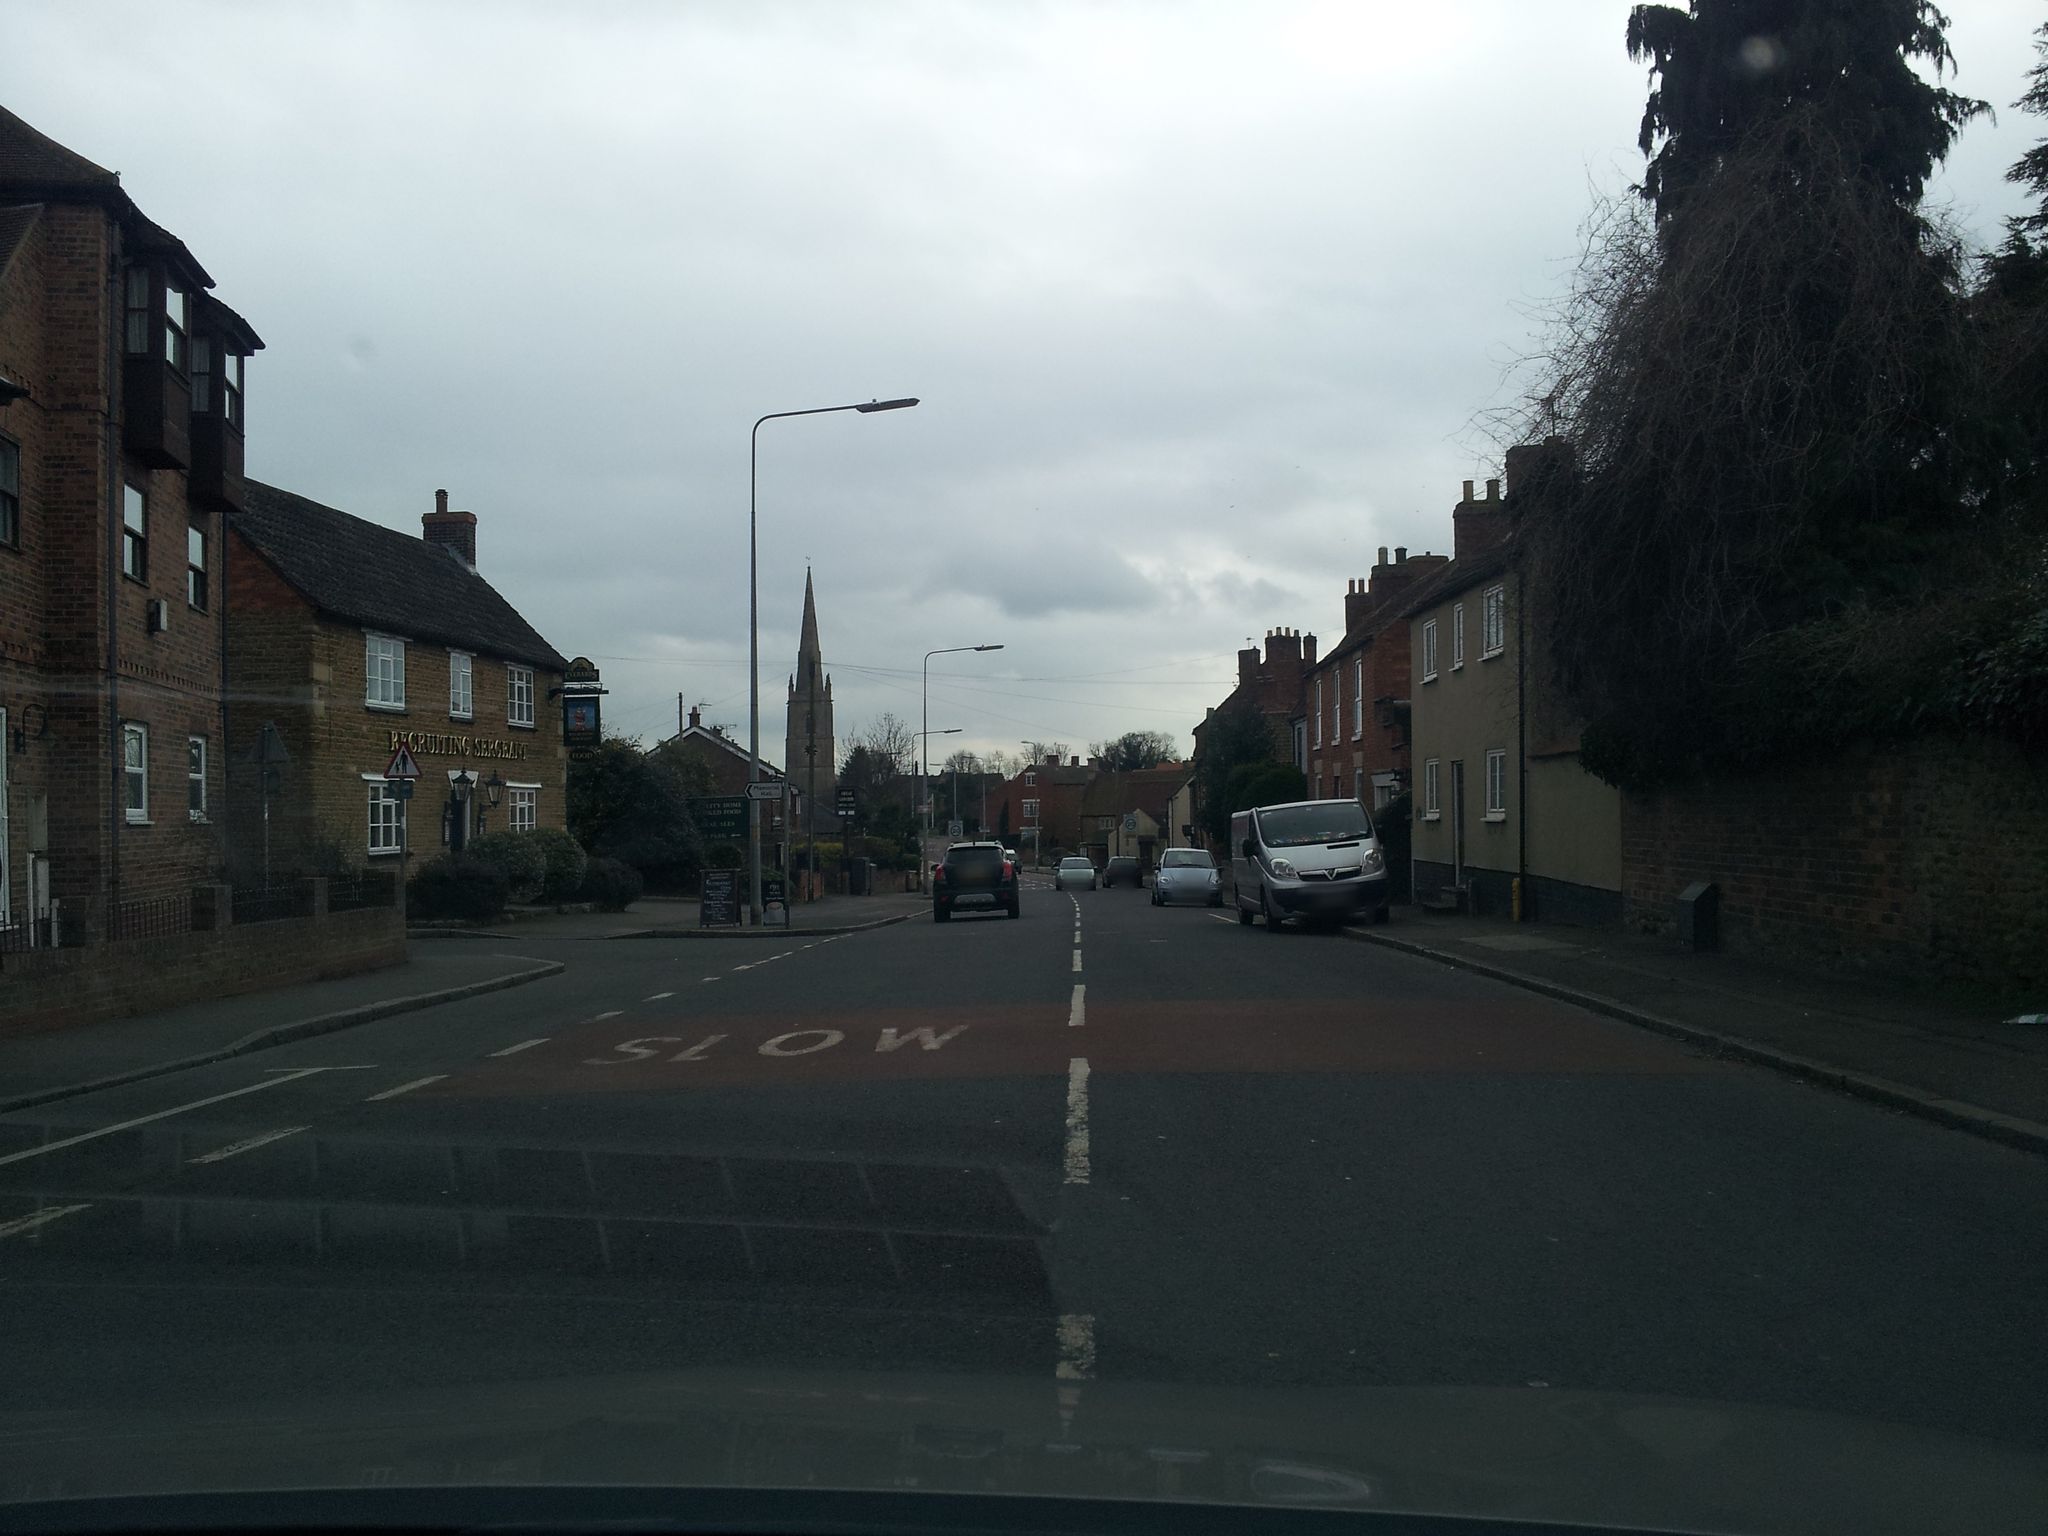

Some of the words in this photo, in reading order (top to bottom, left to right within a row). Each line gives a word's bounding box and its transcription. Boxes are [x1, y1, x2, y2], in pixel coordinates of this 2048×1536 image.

[390, 731, 470, 756] RECRUITING
[474, 738, 529, 760] SERGEANT
[582, 1024, 969, 1065] SLOW
